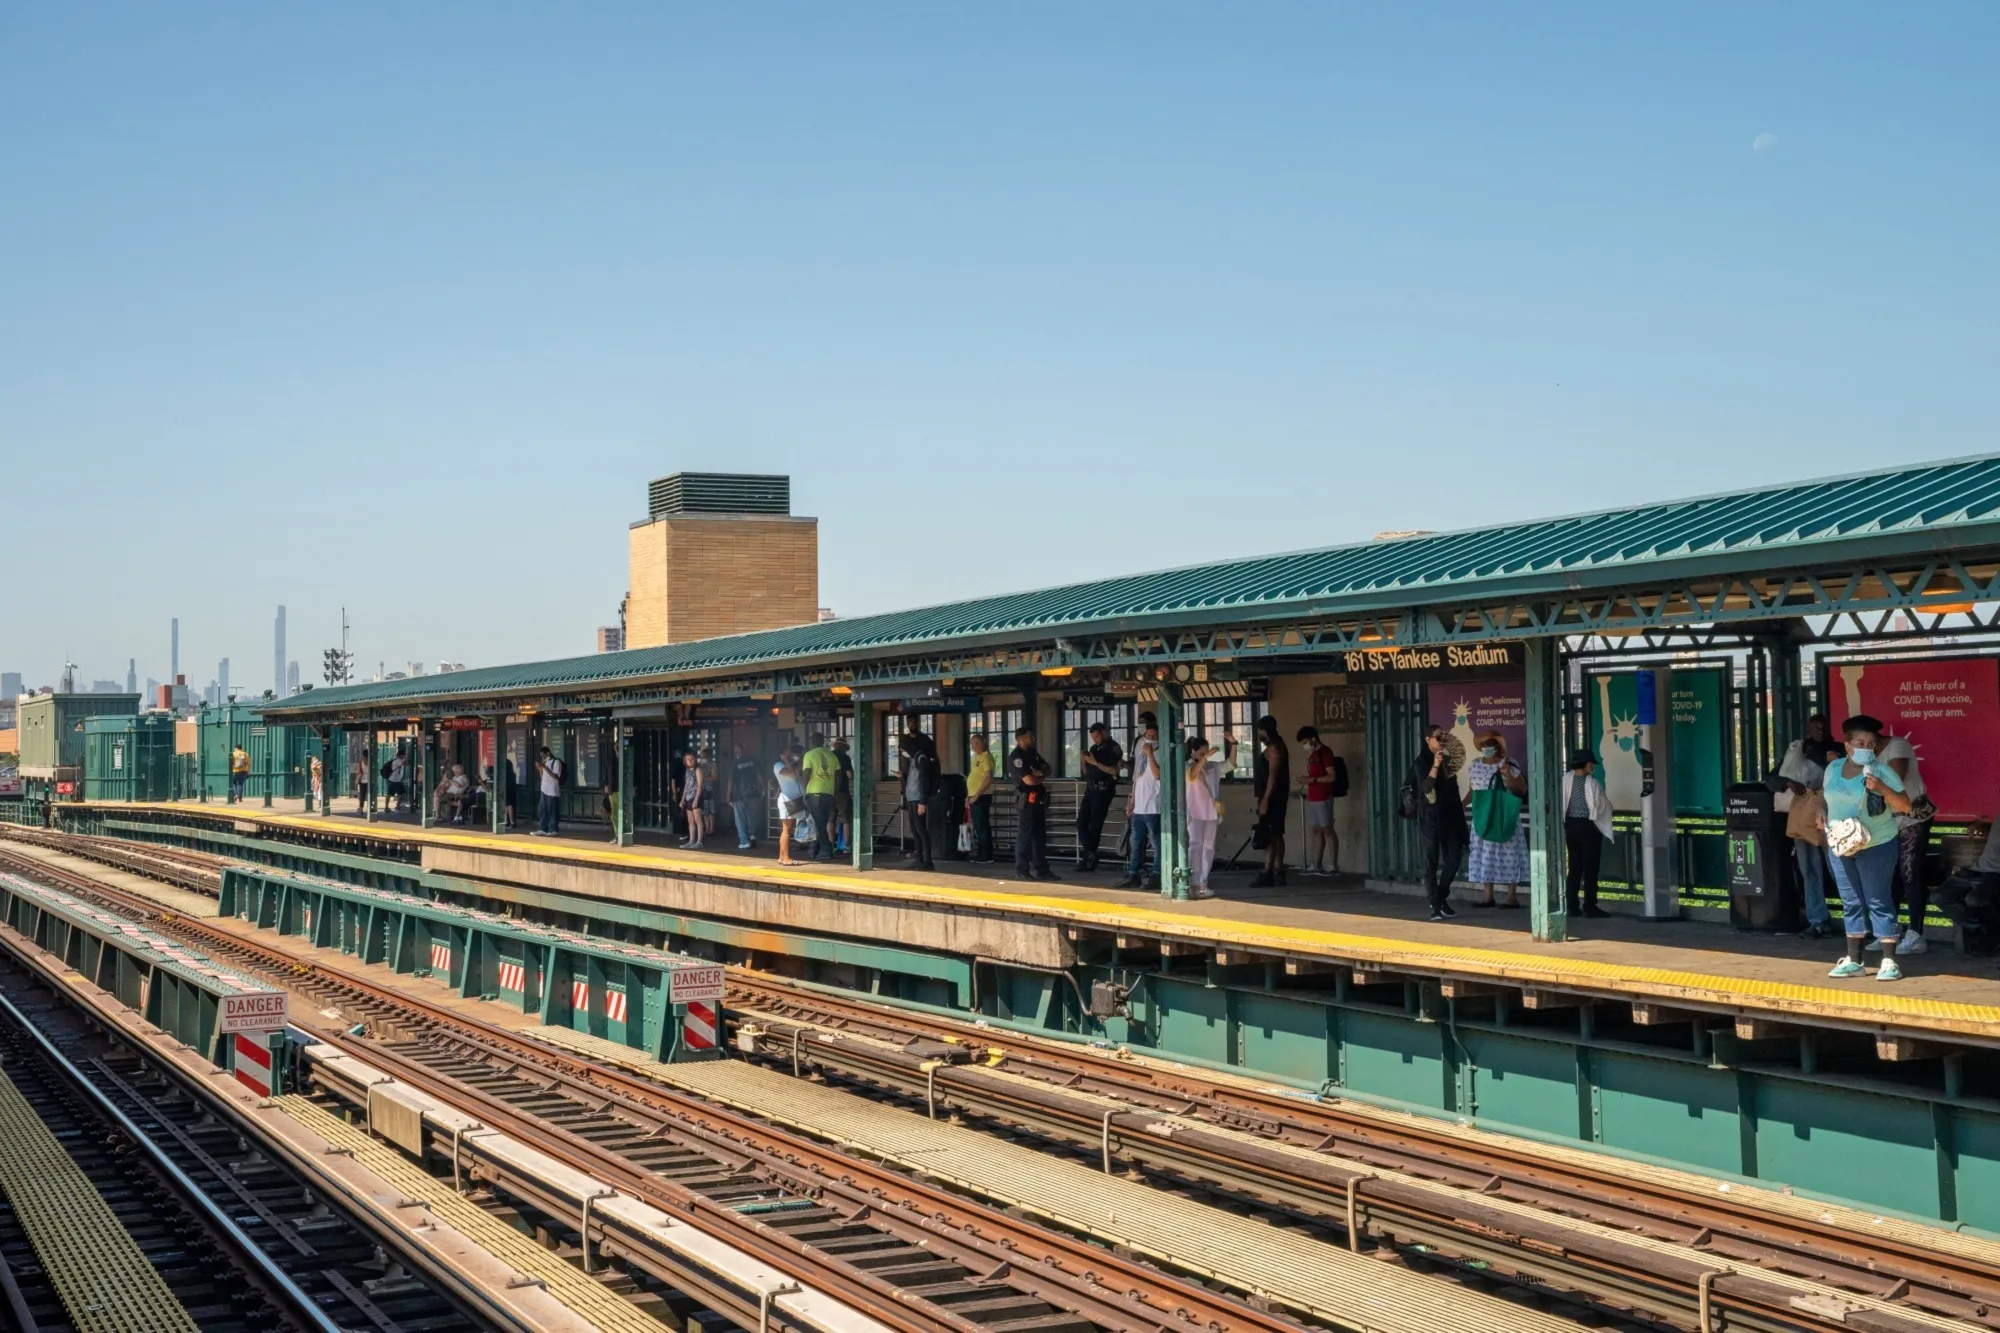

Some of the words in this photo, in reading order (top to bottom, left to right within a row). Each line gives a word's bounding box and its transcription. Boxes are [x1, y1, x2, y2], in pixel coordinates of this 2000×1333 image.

[1344, 652, 1365, 672] 161
[1368, 651, 1440, 671] St-Yankee
[1447, 646, 1508, 667] Stadium
[1900, 682, 1911, 691] All
[1913, 681, 1921, 691] in
[1924, 680, 1946, 690] favor
[1948, 679, 1958, 690] of
[1679, 690, 1694, 698] turn
[1894, 694, 1935, 704] COVID-19
[1936, 693, 1972, 704] vaccine,
[1077, 696, 1104, 704] POLICE
[1480, 696, 1493, 705] NYC
[1494, 696, 1522, 704] welcomes
[1476, 708, 1503, 717] everyone
[1510, 708, 1521, 717] get
[1901, 708, 1921, 718] raise
[1923, 711, 1943, 720] your
[1945, 709, 1966, 717] arm.
[451, 719, 461, 727] No
[464, 718, 477, 727] Exit
[1476, 718, 1502, 727] COVID-19
[1675, 712, 1697, 724] today.
[1740, 806, 1759, 814] Here
[674, 971, 720, 985] DANGER
[686, 989, 720, 998] CLEARANCE
[227, 997, 283, 1013] DANGER
[240, 1016, 282, 1027] CLEARANCE
